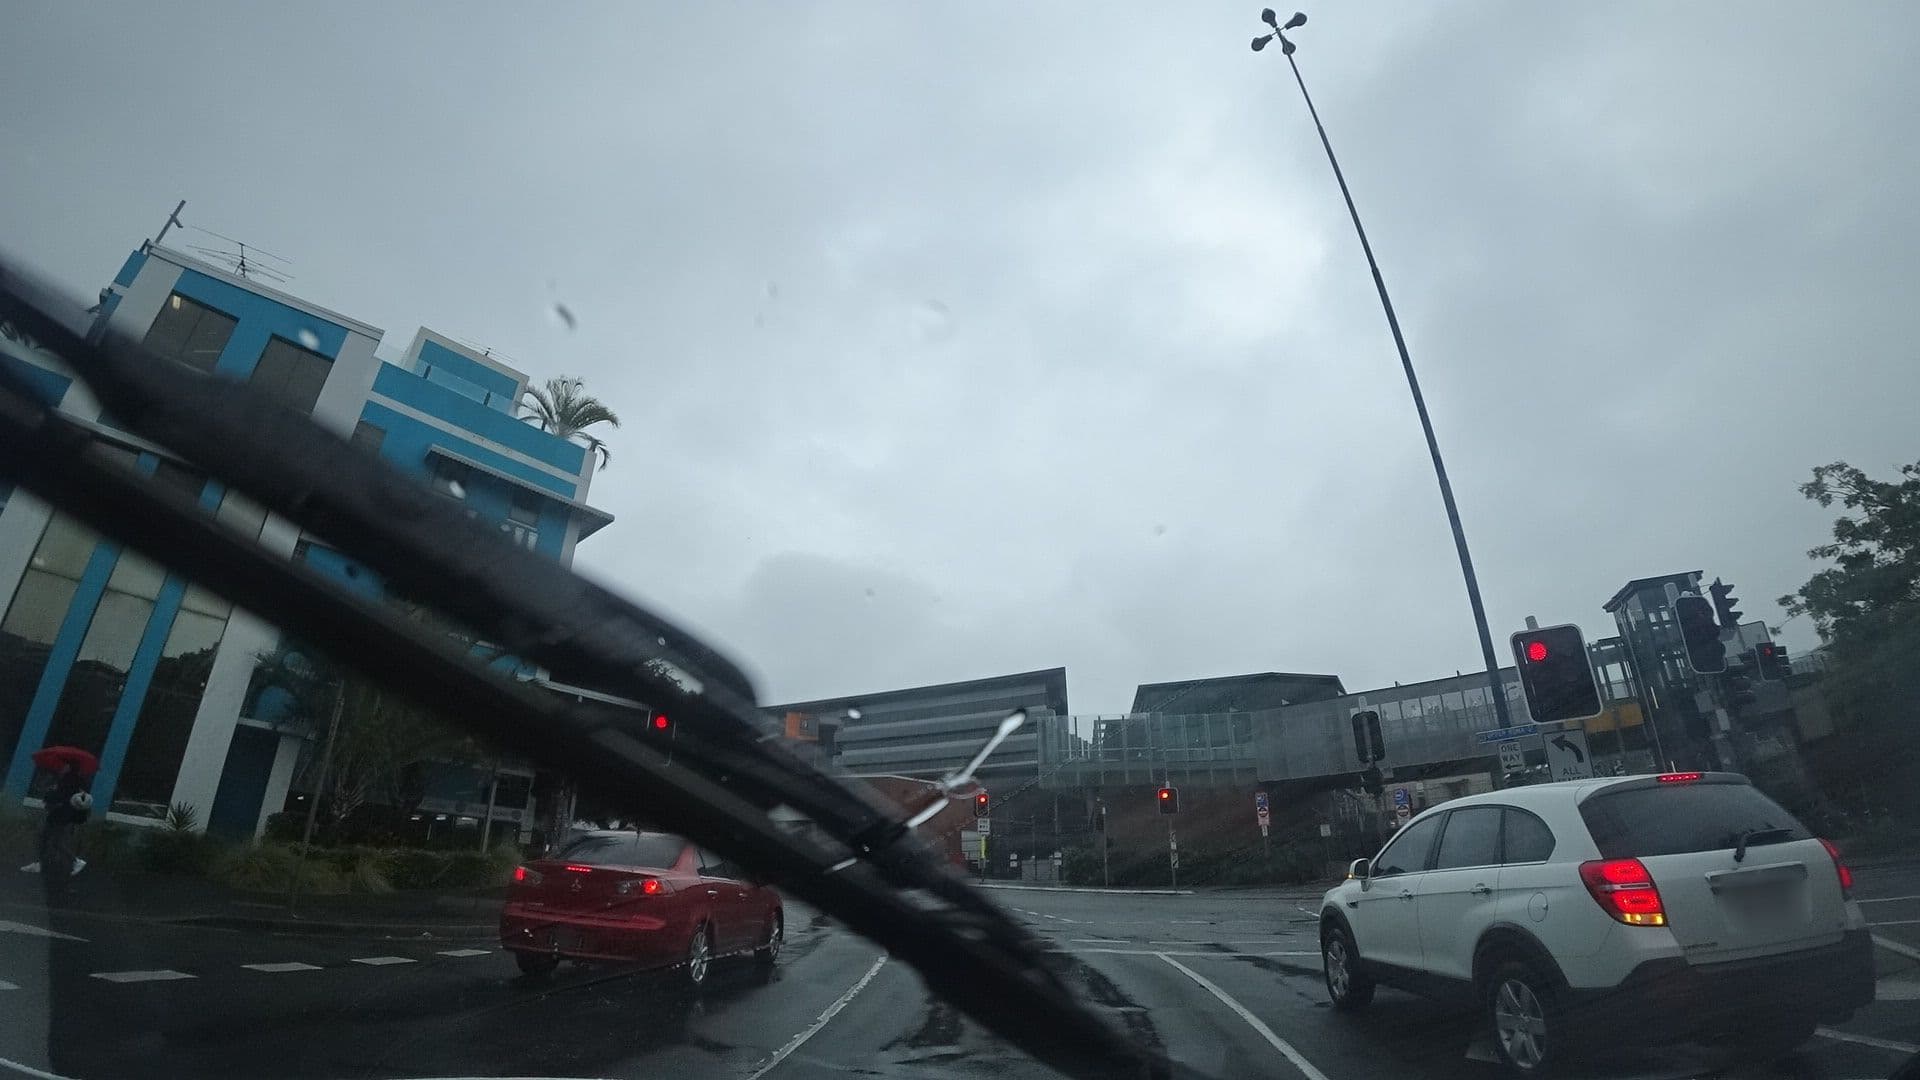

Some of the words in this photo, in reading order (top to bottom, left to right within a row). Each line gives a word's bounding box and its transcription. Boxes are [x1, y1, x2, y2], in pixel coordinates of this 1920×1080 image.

[1501, 743, 1520, 752] ONE
[1501, 754, 1521, 763] WAY
[1562, 766, 1583, 776] ALL
